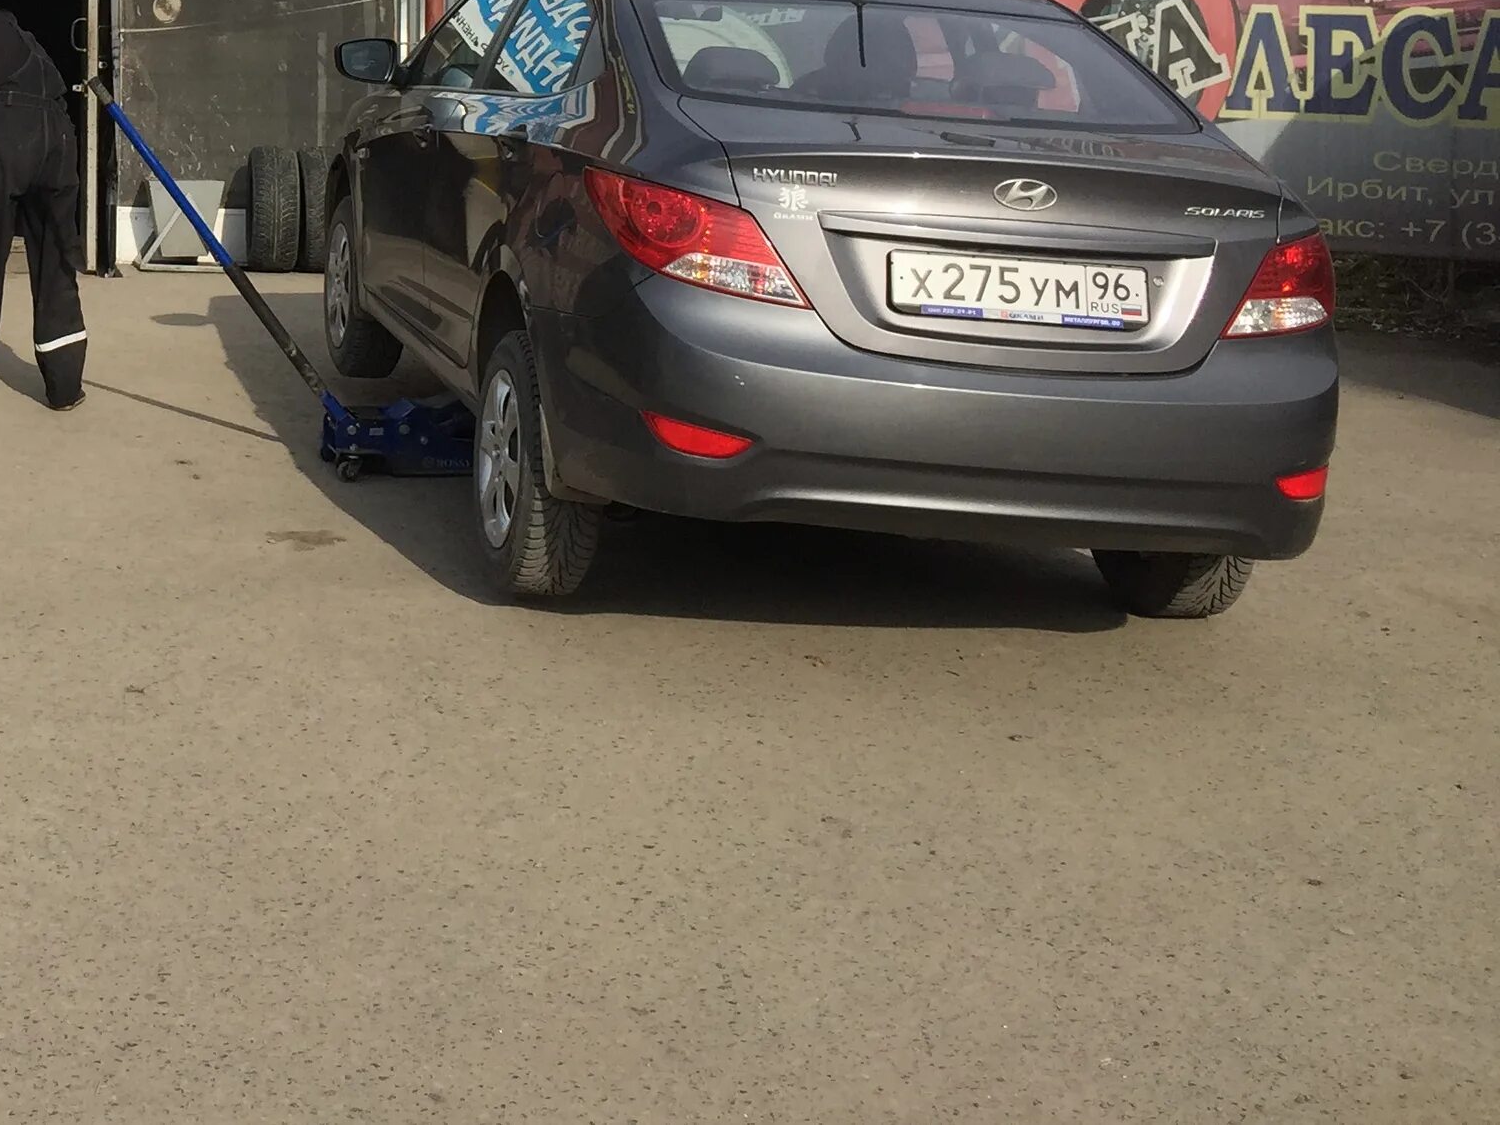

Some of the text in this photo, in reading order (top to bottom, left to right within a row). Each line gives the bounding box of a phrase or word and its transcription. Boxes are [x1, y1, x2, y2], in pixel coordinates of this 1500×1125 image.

[752, 168, 838, 187] HYUNDAI
[1373, 151, 1500, 180] Сверд
[1307, 176, 1433, 206] Ирбит,
[1184, 206, 1266, 219] SOLARIS
[1317, 218, 1385, 239] акс:
[1400, 218, 1446, 244] +7
[1092, 271, 1131, 300] 96
[1090, 302, 1120, 314] RUS
